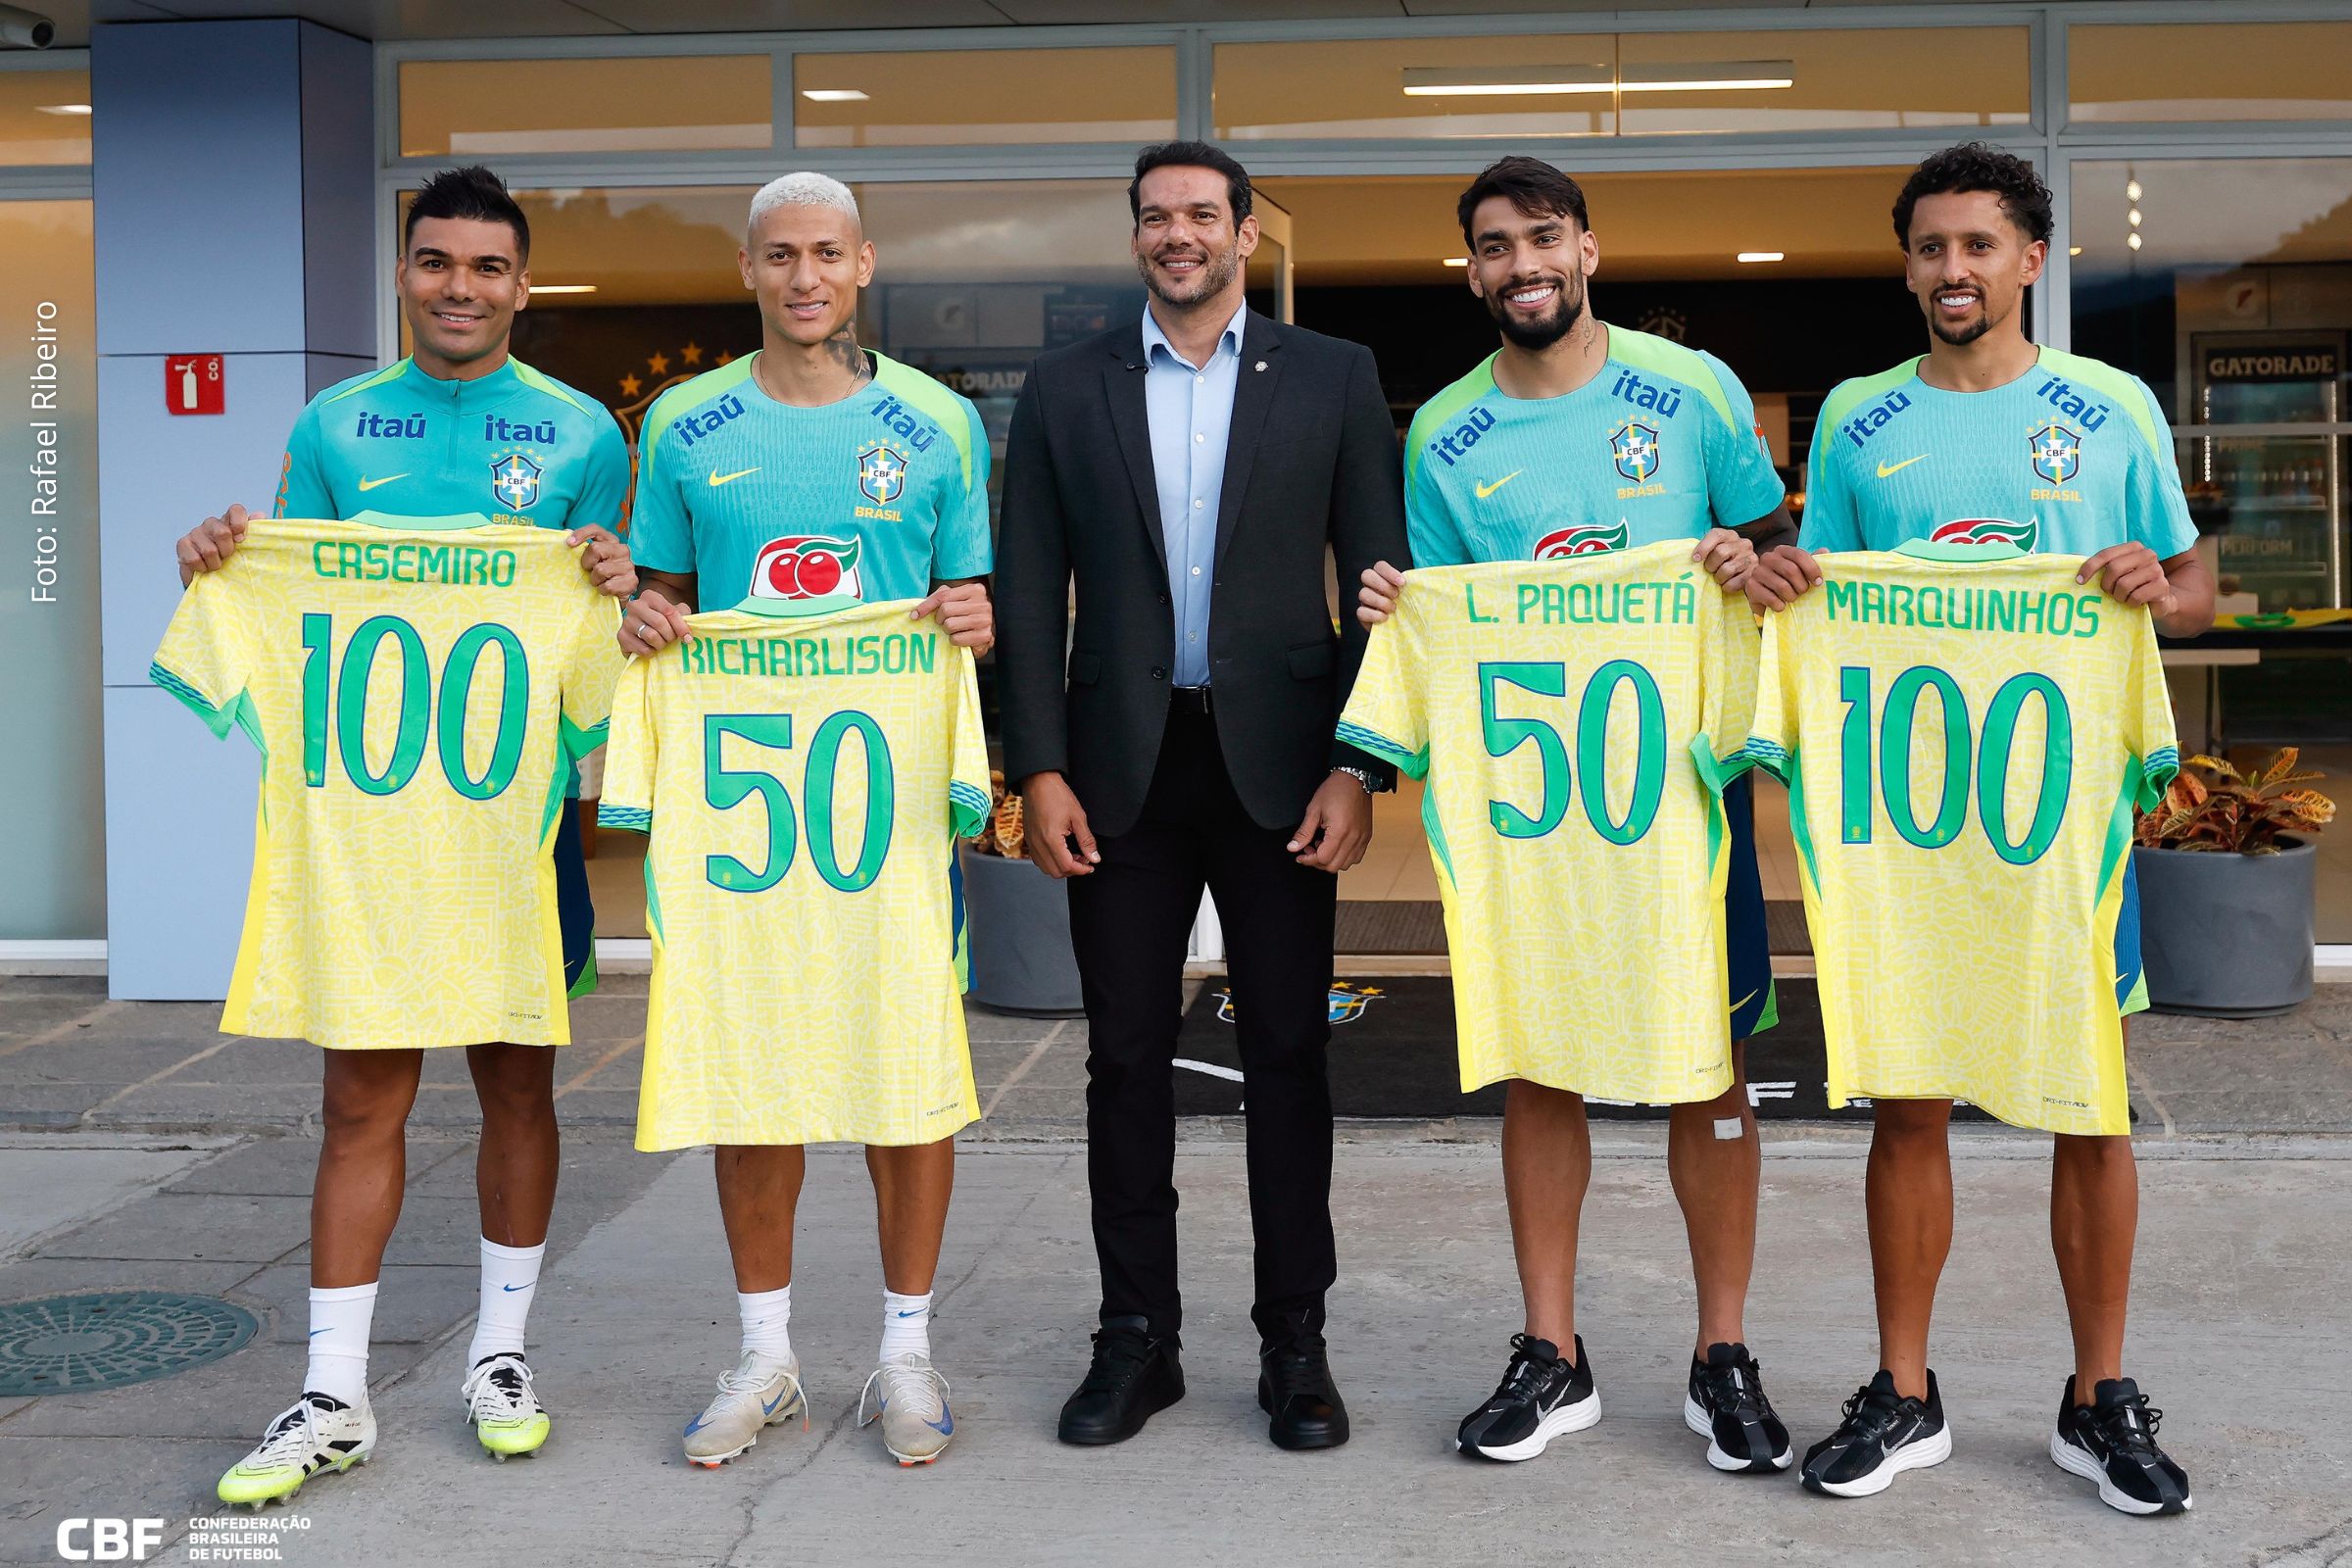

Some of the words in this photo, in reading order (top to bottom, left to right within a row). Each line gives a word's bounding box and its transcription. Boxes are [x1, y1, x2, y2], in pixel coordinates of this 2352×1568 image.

[2209, 354, 2334, 376] GATORADE
[1611, 368, 1682, 419] itaú
[2036, 376, 2109, 434] itaú
[357, 412, 427, 439] itaú
[485, 414, 557, 445] itaú
[673, 392, 746, 447] itaú
[869, 395, 938, 454] itaú
[1430, 406, 1496, 467] itaú
[1842, 390, 1912, 449] itaú
[873, 468, 893, 479] CBF
[1626, 447, 1645, 457] CBF
[2046, 449, 2066, 459] CBF
[508, 477, 525, 486] CBF
[1617, 483, 1667, 500] BRASIL
[2031, 489, 2082, 502] BRASIL
[855, 507, 903, 522] BRASIL
[313, 541, 516, 587] CASEMIRO
[1465, 583, 1499, 623] L.
[1517, 571, 1695, 624] PAQUETÁ
[1825, 580, 2102, 638] MARQUINHOS
[680, 632, 936, 676] RICHARLISON
[303, 612, 529, 801] 100
[1478, 659, 1667, 846] 50
[1840, 665, 2073, 866] 100
[704, 710, 895, 893] 50
